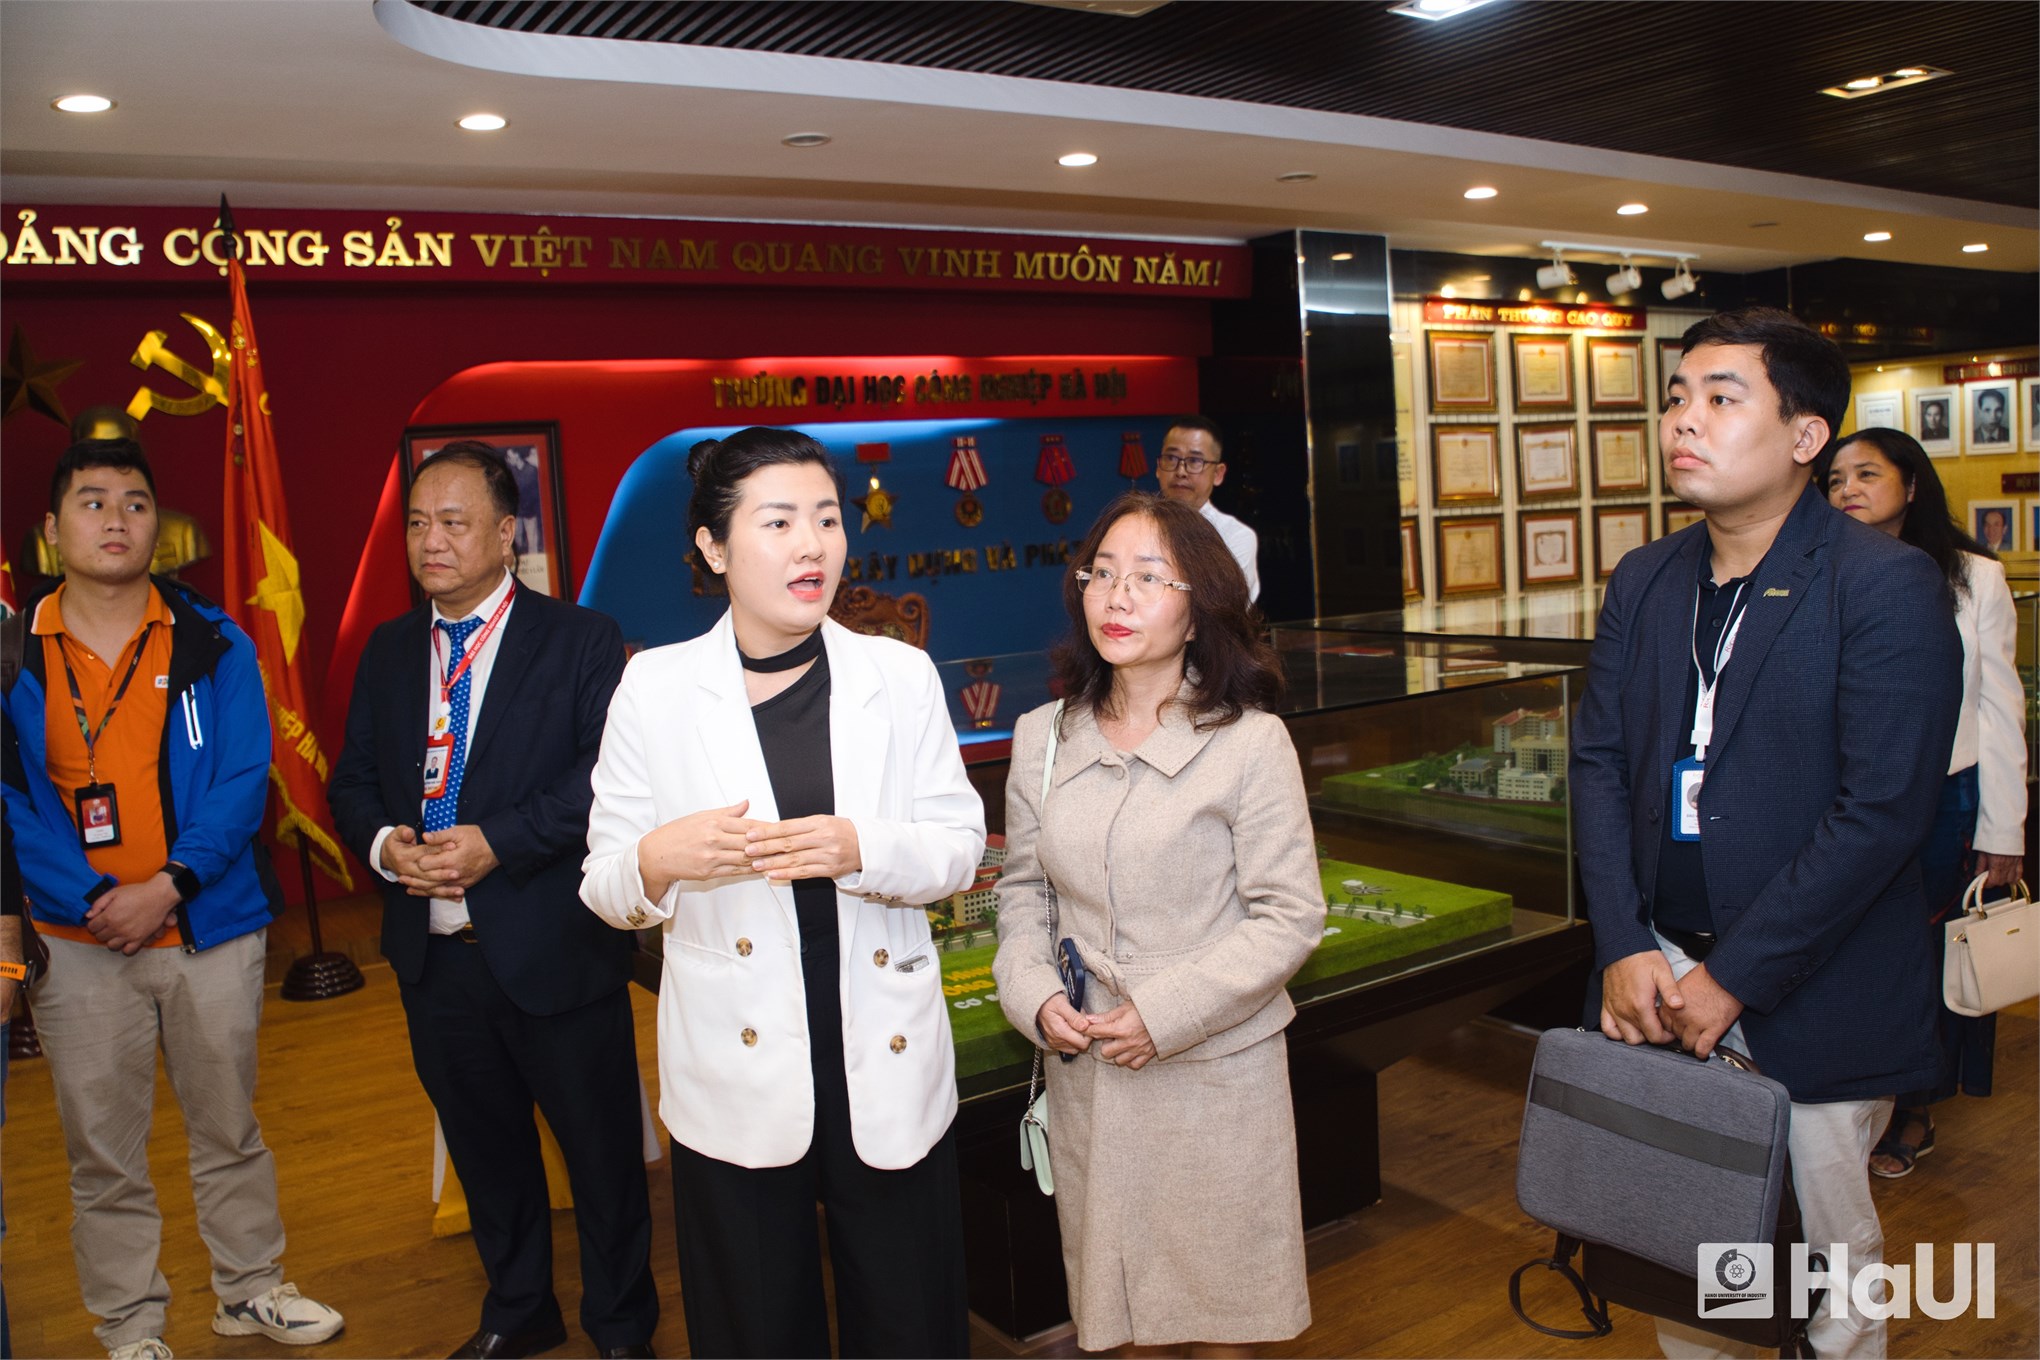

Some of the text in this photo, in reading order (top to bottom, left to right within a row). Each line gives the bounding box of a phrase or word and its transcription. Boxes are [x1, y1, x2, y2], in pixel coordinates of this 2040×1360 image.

[0, 209, 144, 265] ẢNG
[343, 216, 454, 267] SẢN
[471, 225, 593, 277] VIỆT
[608, 236, 719, 270] NAM
[731, 240, 885, 274] QUANG
[897, 246, 1001, 279] VINH
[1013, 243, 1122, 283] MUÔN
[1133, 251, 1223, 287] NĂM!
